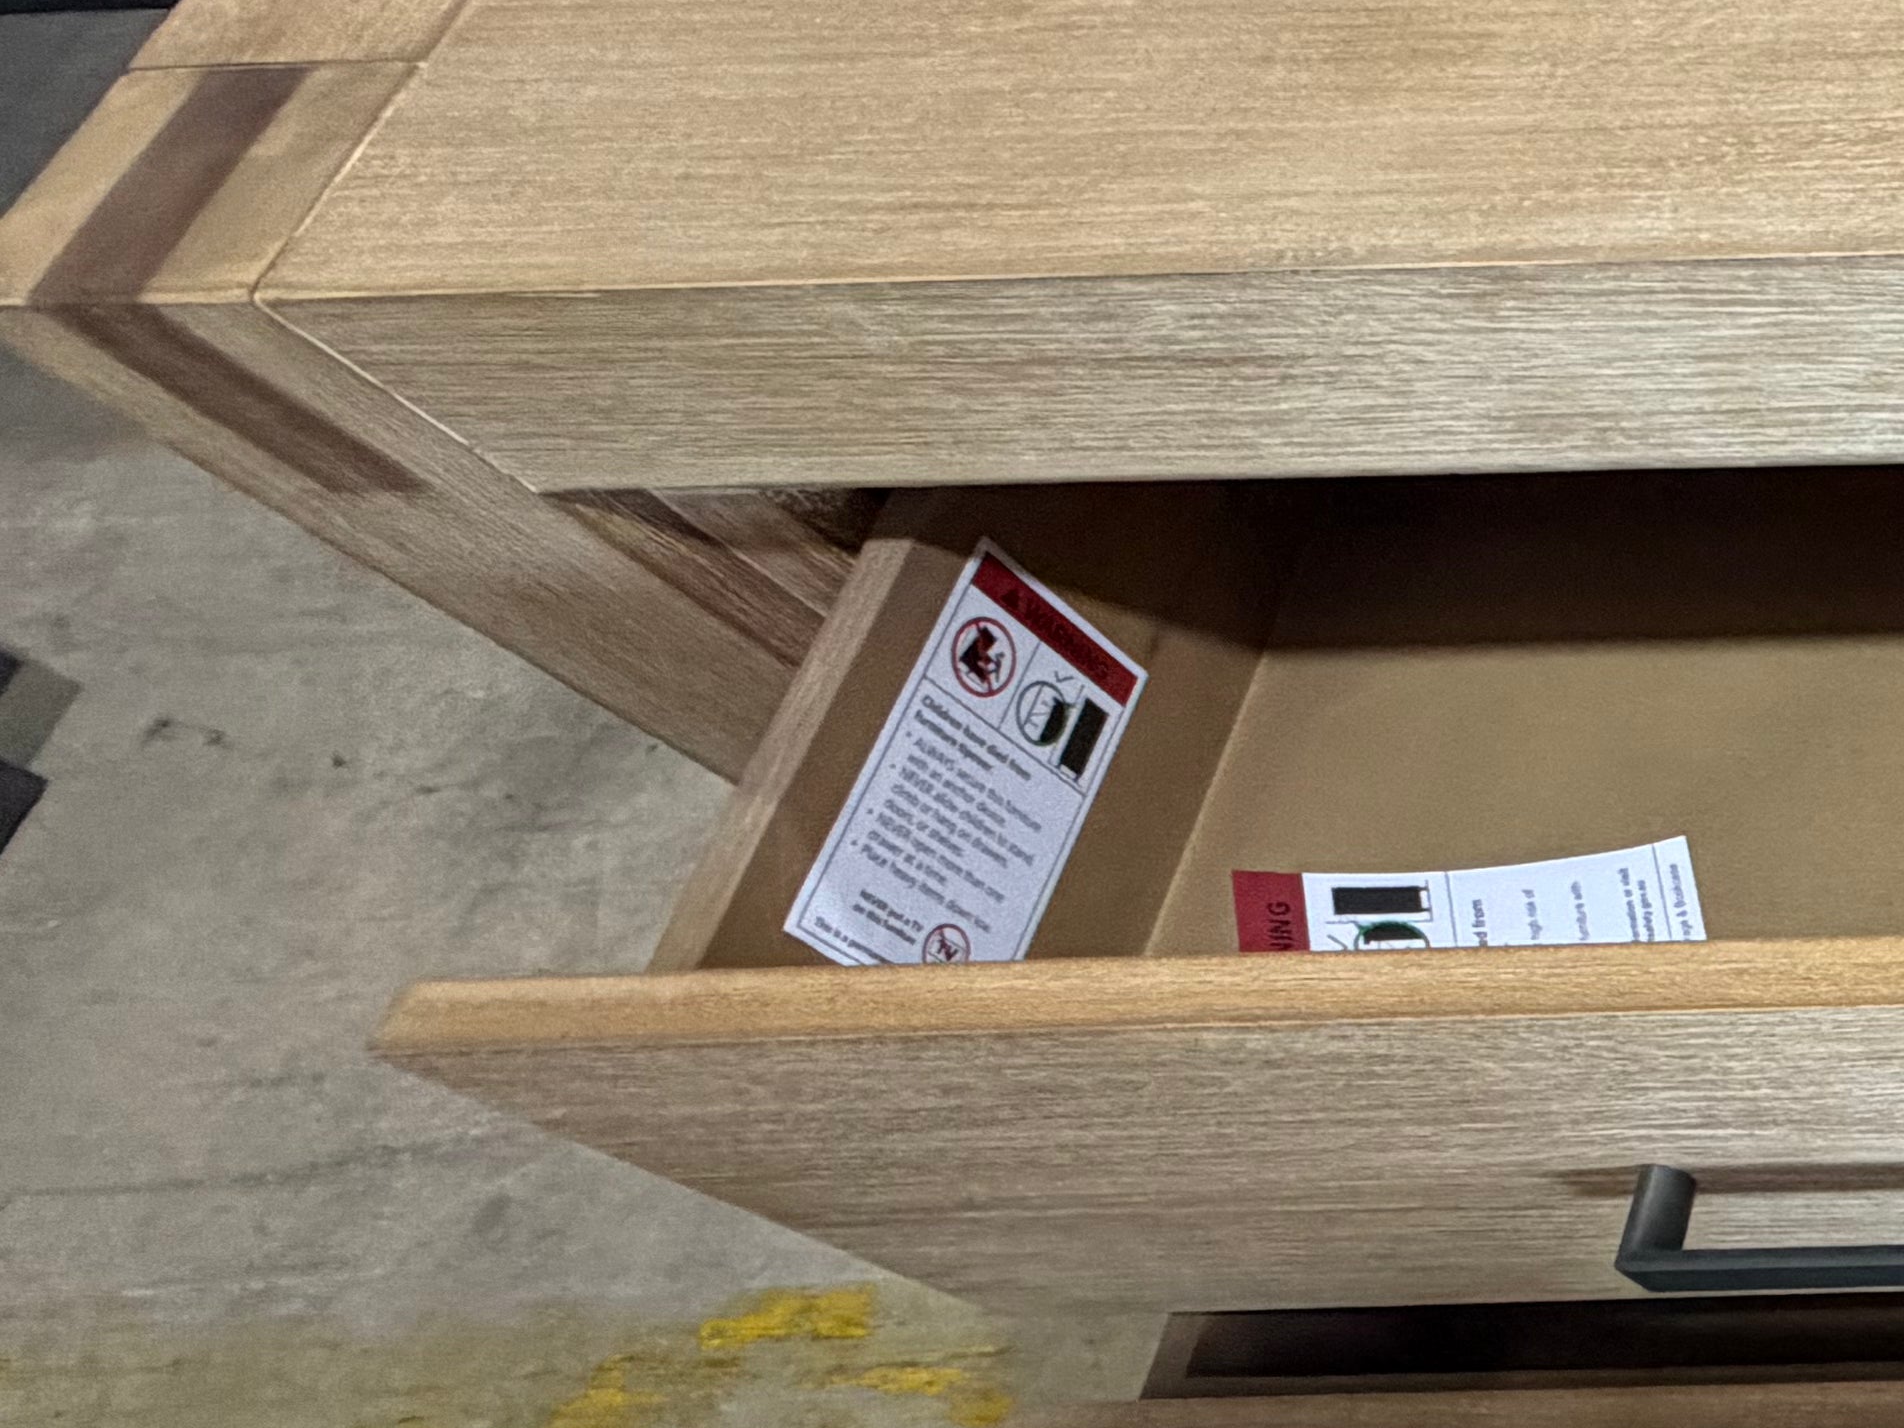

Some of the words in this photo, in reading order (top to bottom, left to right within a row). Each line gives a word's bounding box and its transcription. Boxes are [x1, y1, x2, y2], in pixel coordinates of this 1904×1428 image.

[1021, 596, 1112, 681] WARNING
[913, 708, 959, 748] furniture
[919, 692, 964, 731] Children
[961, 723, 988, 749] have
[985, 740, 1009, 765] died
[1007, 756, 1033, 782] from
[906, 750, 930, 773] with
[898, 764, 933, 796] NEVER
[957, 805, 998, 841] children
[912, 735, 956, 773] ALWAYS
[955, 767, 986, 794] secure
[985, 786, 1005, 807] this
[1003, 799, 1043, 833] furniture
[889, 779, 921, 808] climb
[928, 807, 958, 836] hang
[866, 827, 904, 859] drawer
[874, 810, 912, 843] NEVER
[908, 835, 937, 862] open
[936, 853, 963, 877] more
[962, 869, 985, 891] than
[984, 884, 1005, 904] one
[859, 842, 889, 869] Place
[886, 861, 918, 890] heavy
[916, 880, 946, 906] items
[944, 897, 975, 925] down
[1521, 889, 1535, 899] of
[1624, 889, 1633, 898] or
[813, 915, 833, 934] This
[858, 887, 889, 913] NEVER
[910, 919, 924, 934] TV
[1471, 899, 1485, 928] from
[1528, 920, 1542, 940] high
[1472, 932, 1488, 947] ed
